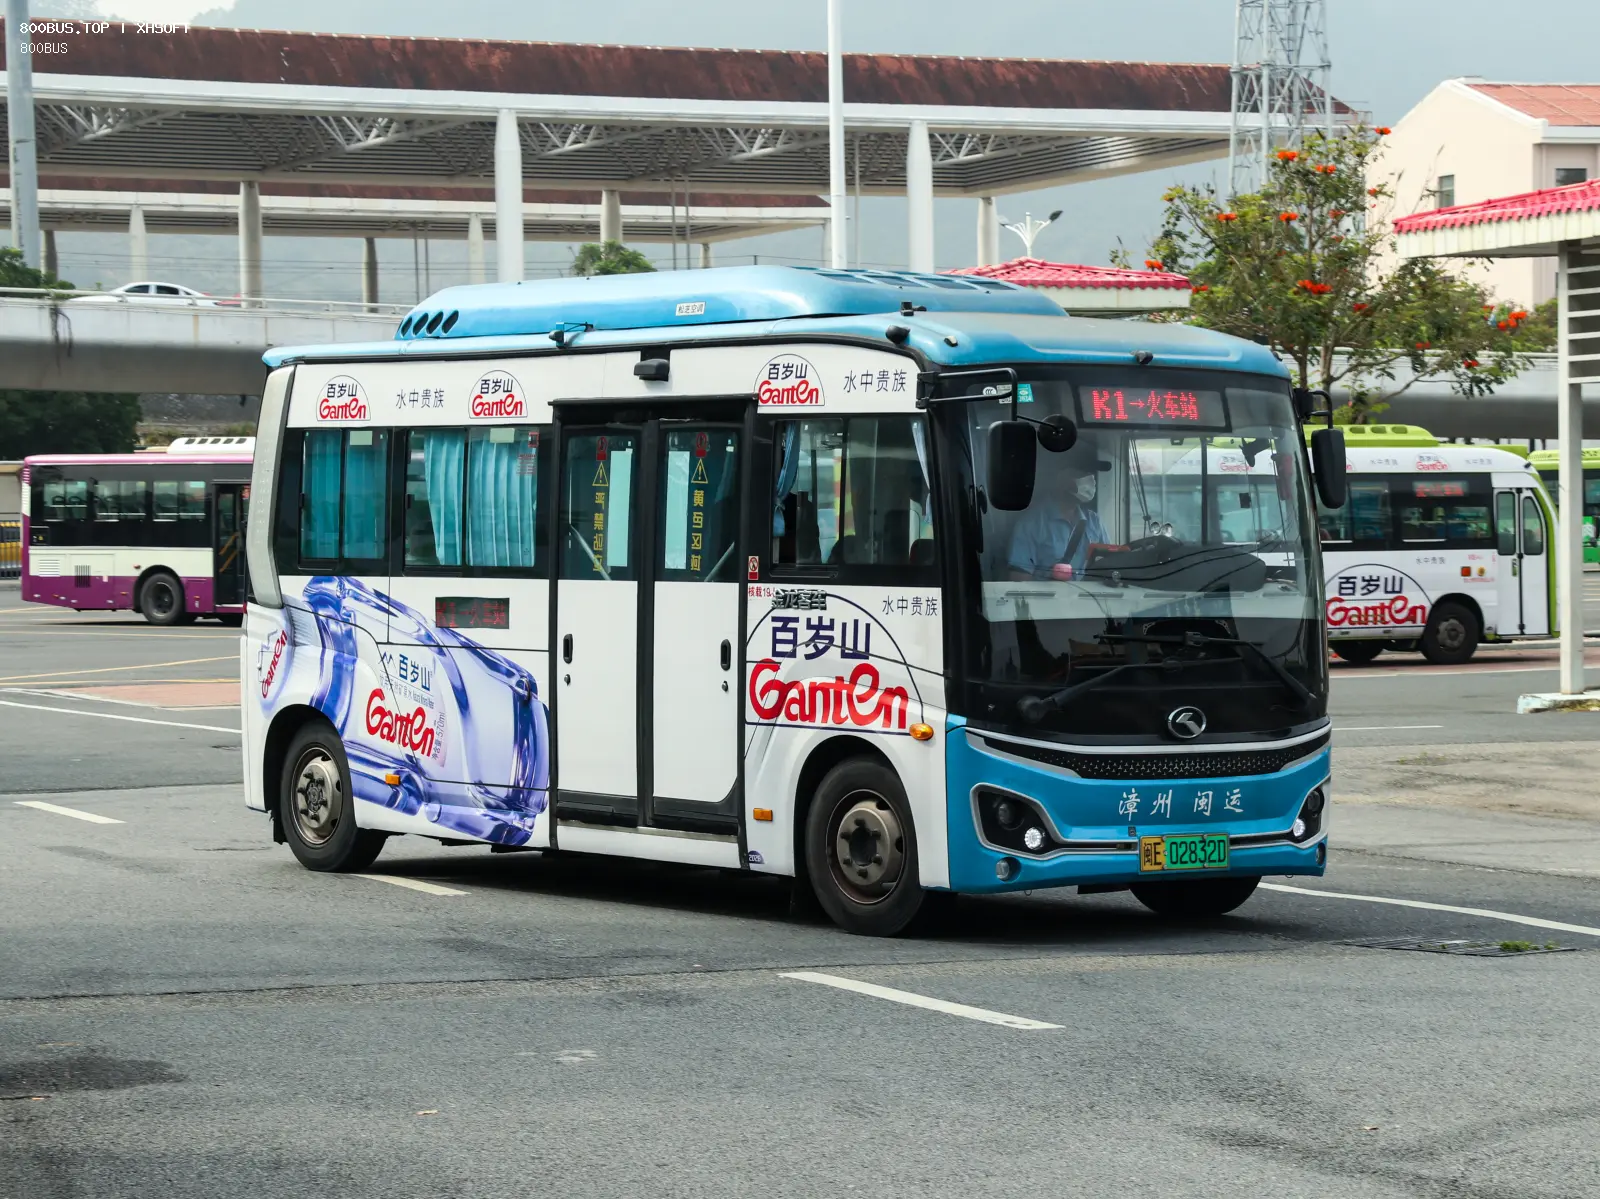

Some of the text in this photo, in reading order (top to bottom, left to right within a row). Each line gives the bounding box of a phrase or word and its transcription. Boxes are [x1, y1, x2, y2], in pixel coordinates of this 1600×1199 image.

[767, 362, 808, 380] 百岁山
[843, 368, 908, 394] 水中贵族
[326, 383, 358, 399] 百岁山
[395, 387, 445, 409] 水中贵族
[480, 378, 514, 395] 百岁山
[758, 379, 819, 405] Ganten
[319, 397, 367, 420] Ganten
[471, 393, 524, 418] Ganten
[1092, 389, 1199, 421] K1 火车站
[1338, 574, 1404, 596] 百岁山
[771, 588, 828, 611] 金龙客车
[882, 595, 939, 617] 水中贵族
[1326, 595, 1428, 626] Ganten
[771, 615, 871, 661] 百岁山
[398, 653, 431, 692] 百岁山
[749, 658, 910, 730] Ganten
[365, 687, 435, 758] Ganten
[1118, 787, 1244, 822] 漳州 闽运
[1169, 839, 1227, 865] 02832D
